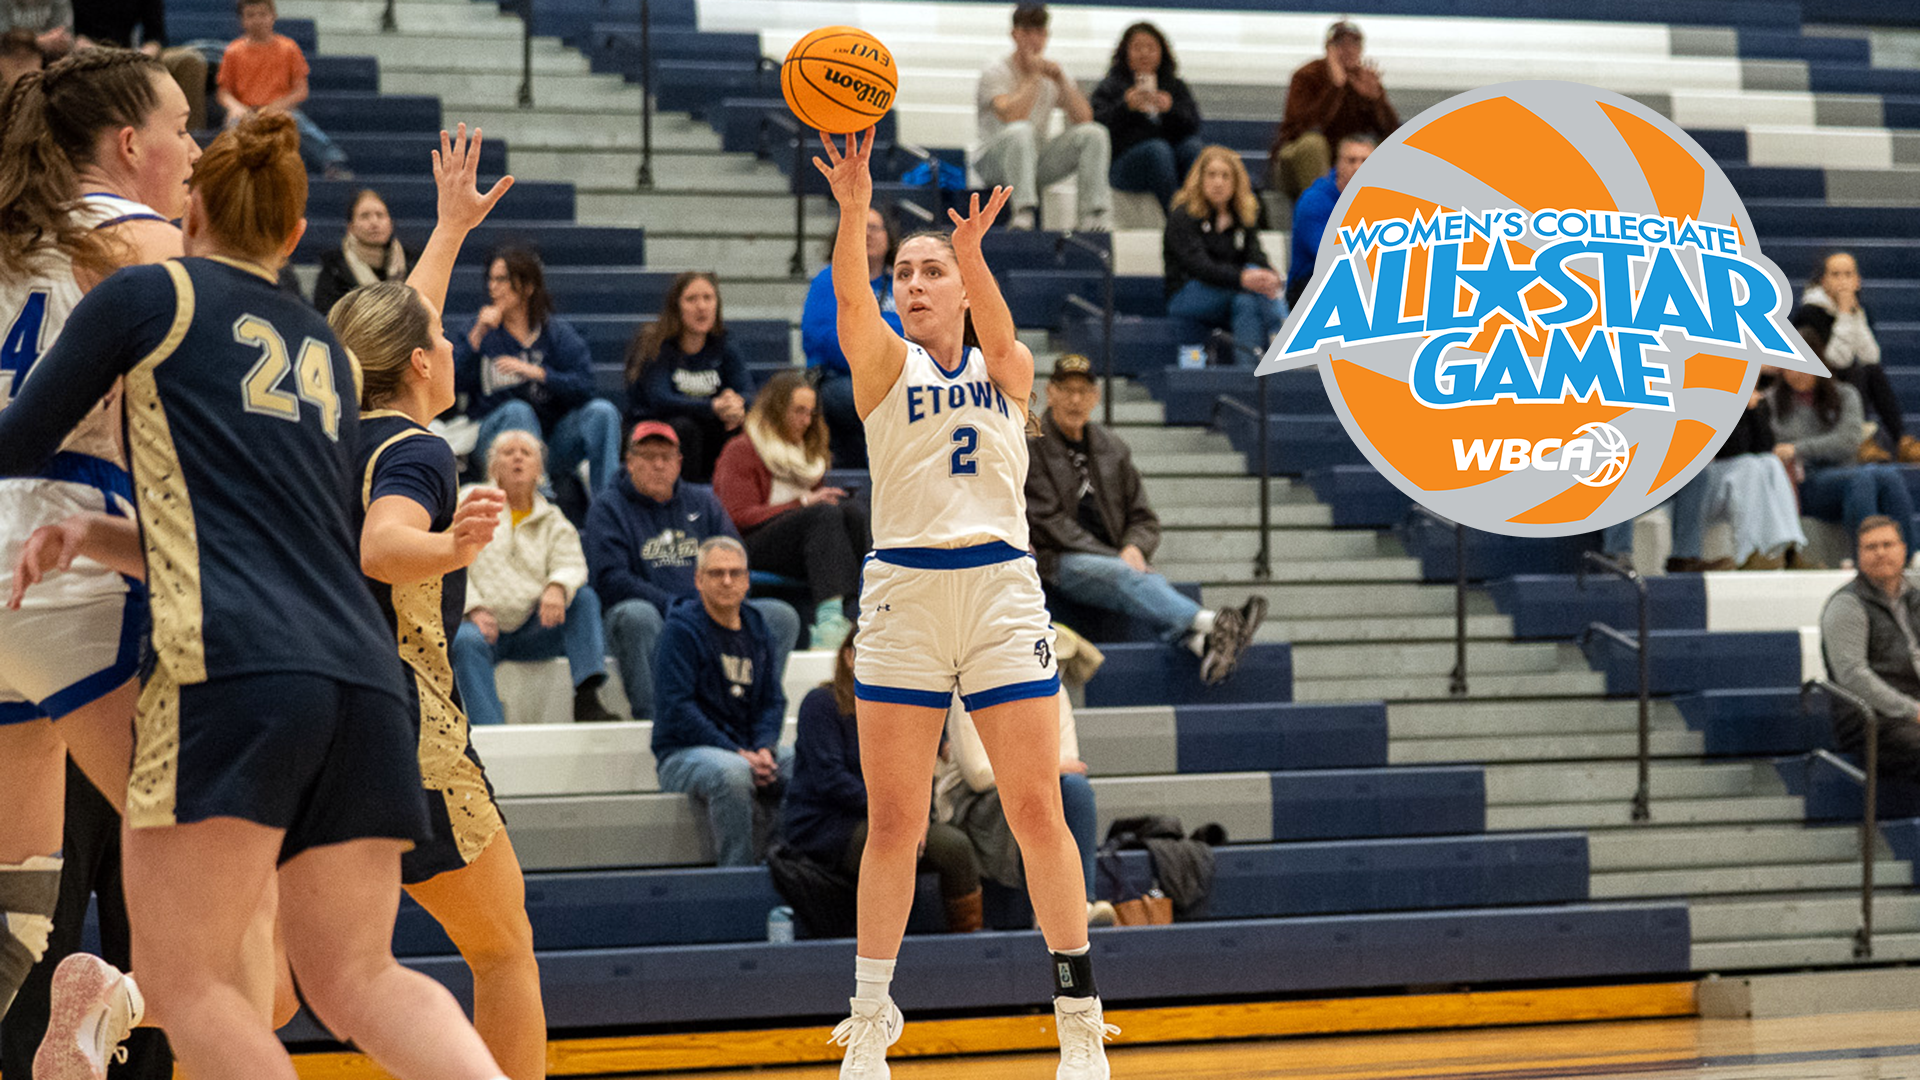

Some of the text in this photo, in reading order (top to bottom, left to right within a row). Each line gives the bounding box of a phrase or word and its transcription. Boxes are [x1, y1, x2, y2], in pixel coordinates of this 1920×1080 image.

[824, 67, 891, 110] Wilson
[0, 287, 52, 402] 4
[232, 312, 342, 442] 24
[948, 423, 981, 478] 2
